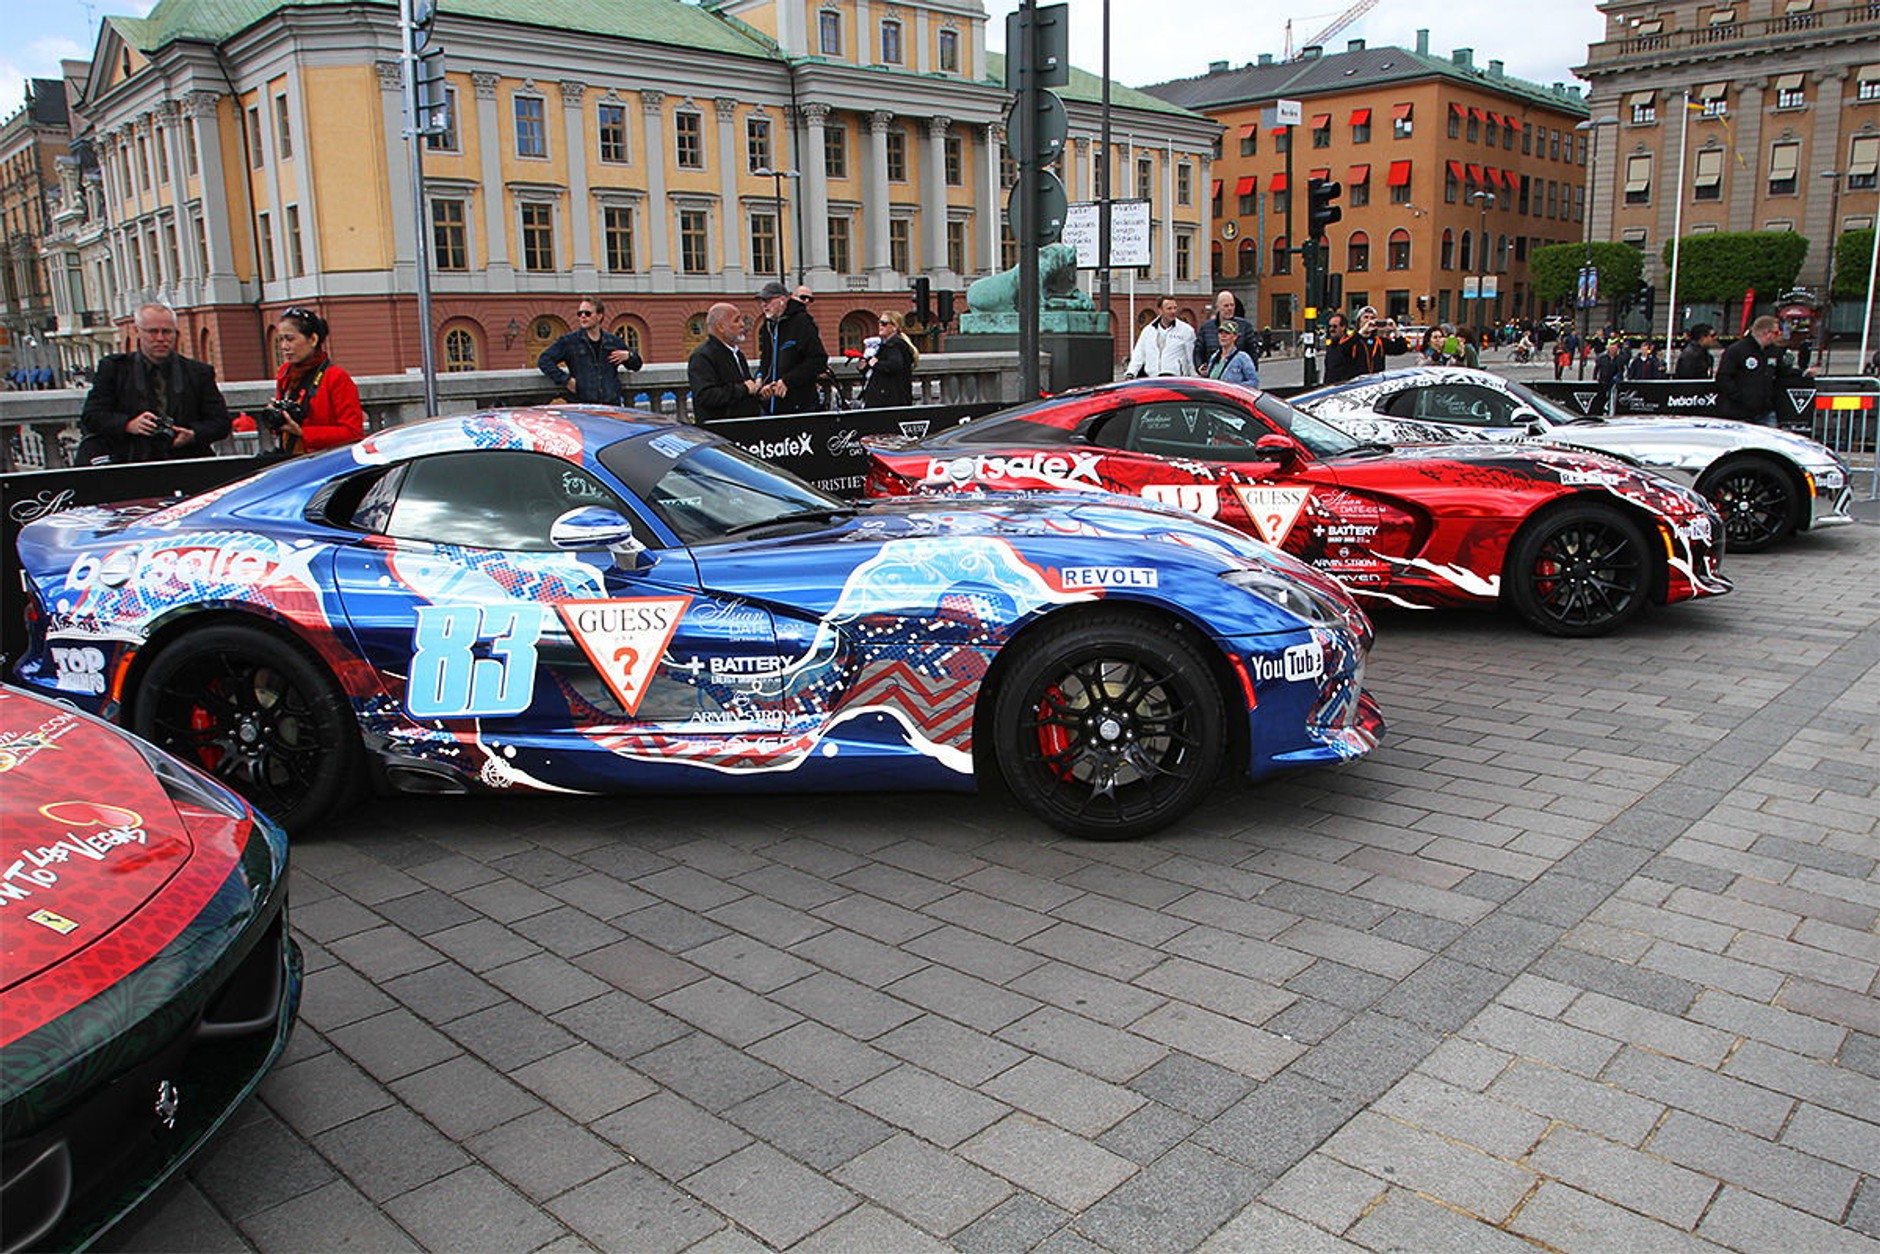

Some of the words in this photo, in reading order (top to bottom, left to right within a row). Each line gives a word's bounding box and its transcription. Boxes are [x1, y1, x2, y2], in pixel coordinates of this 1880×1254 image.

[926, 453, 1070, 485] btsafe
[1246, 489, 1300, 505] GUESS
[1328, 526, 1378, 536] BATTERY
[64, 541, 271, 590] btsafe
[1065, 569, 1154, 585] REVOLT
[578, 606, 668, 633] GUESS
[51, 647, 105, 673] TOP
[404, 602, 541, 719] 83
[709, 655, 795, 674] BATTERY
[1251, 645, 1324, 682] YouTube
